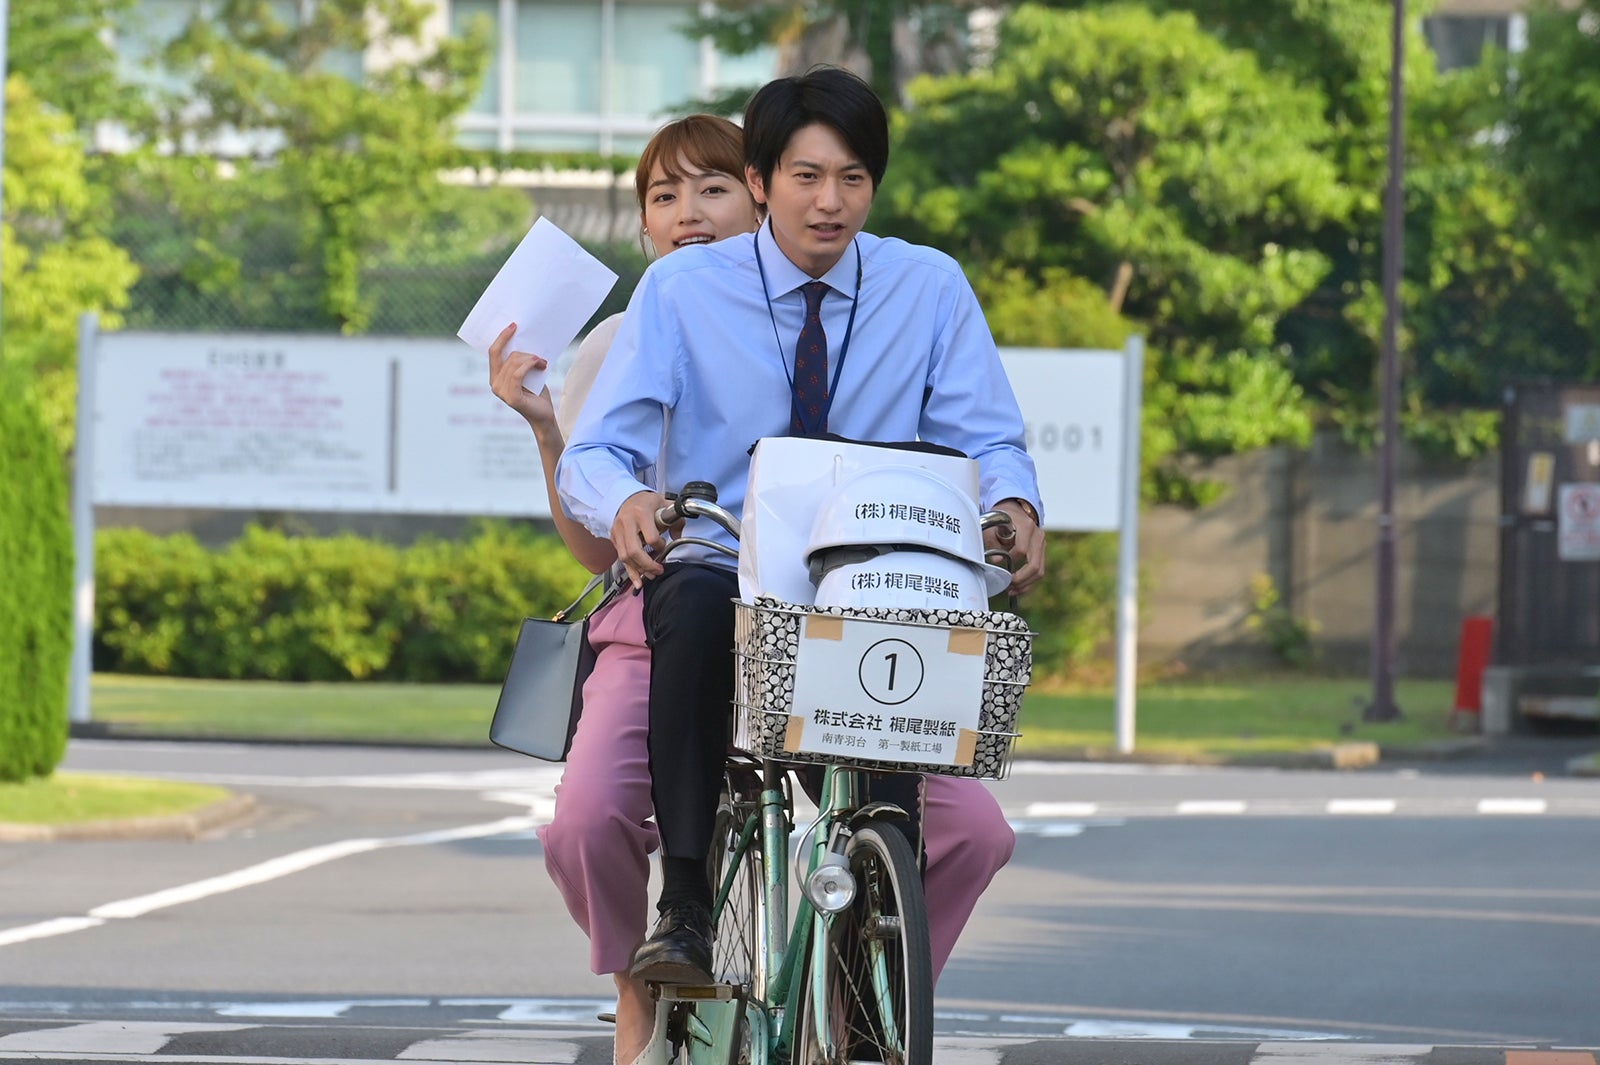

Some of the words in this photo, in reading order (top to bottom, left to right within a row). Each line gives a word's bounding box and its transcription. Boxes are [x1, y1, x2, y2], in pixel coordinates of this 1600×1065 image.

[813, 708, 883, 732] 株式会社
[889, 715, 957, 738] 梶尾製紙
[821, 732, 867, 748] 南青羽台
[878, 738, 943, 754] 第一製紙工場
